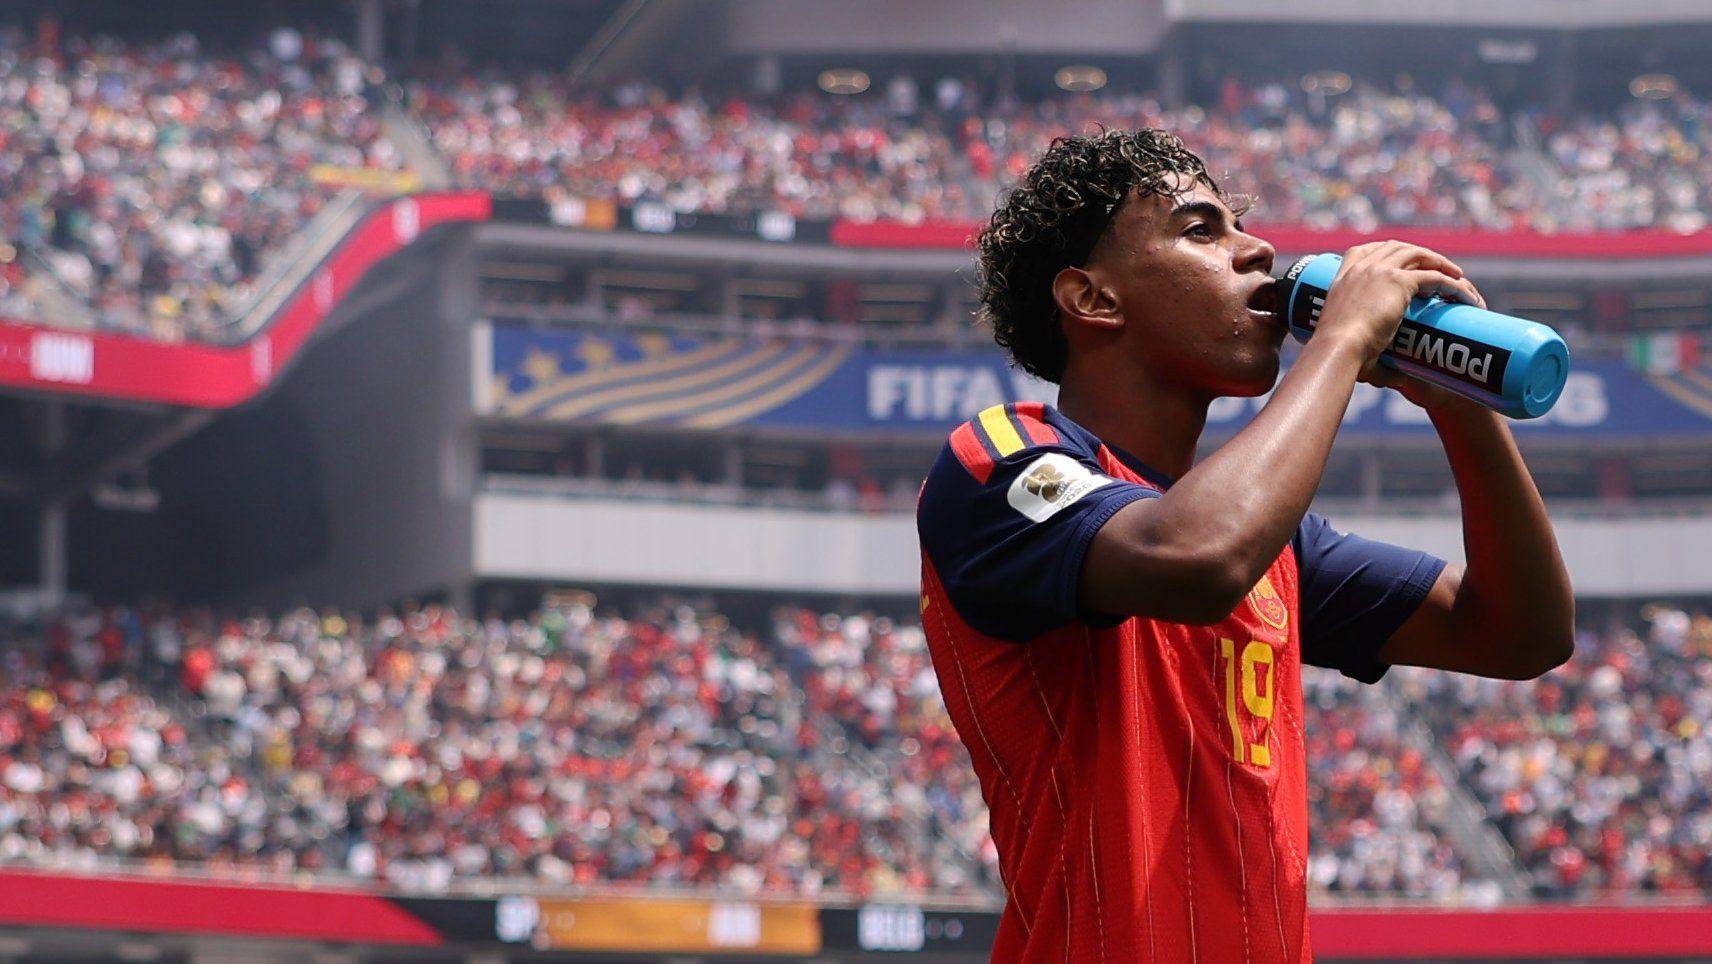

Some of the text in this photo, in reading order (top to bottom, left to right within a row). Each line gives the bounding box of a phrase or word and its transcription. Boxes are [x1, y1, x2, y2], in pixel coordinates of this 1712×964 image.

[1395, 326, 1492, 383] POWE
[869, 365, 1006, 421] FIFA
[1220, 638, 1274, 767] 19
